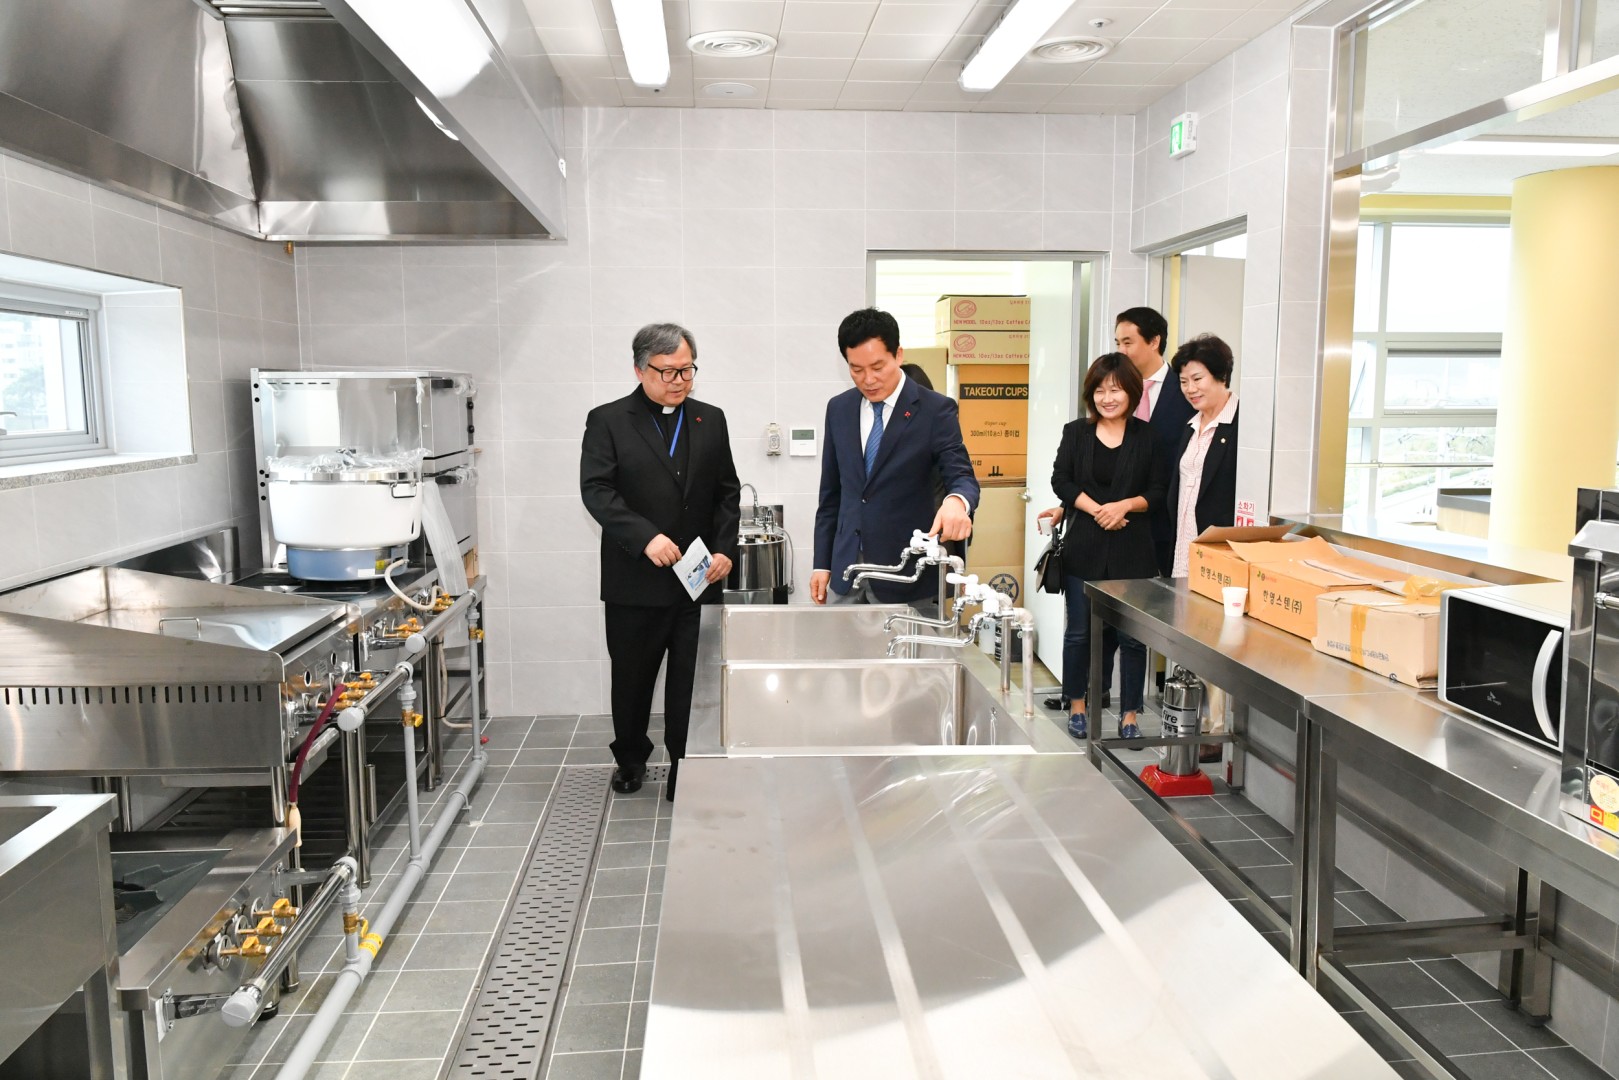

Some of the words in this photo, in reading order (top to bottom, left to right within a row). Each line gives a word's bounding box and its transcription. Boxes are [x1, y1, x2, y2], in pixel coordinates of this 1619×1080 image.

[964, 387, 1004, 396] TAKEOUT
[1005, 387, 1028, 396] CUPS
[1238, 501, 1255, 512] 소화기
